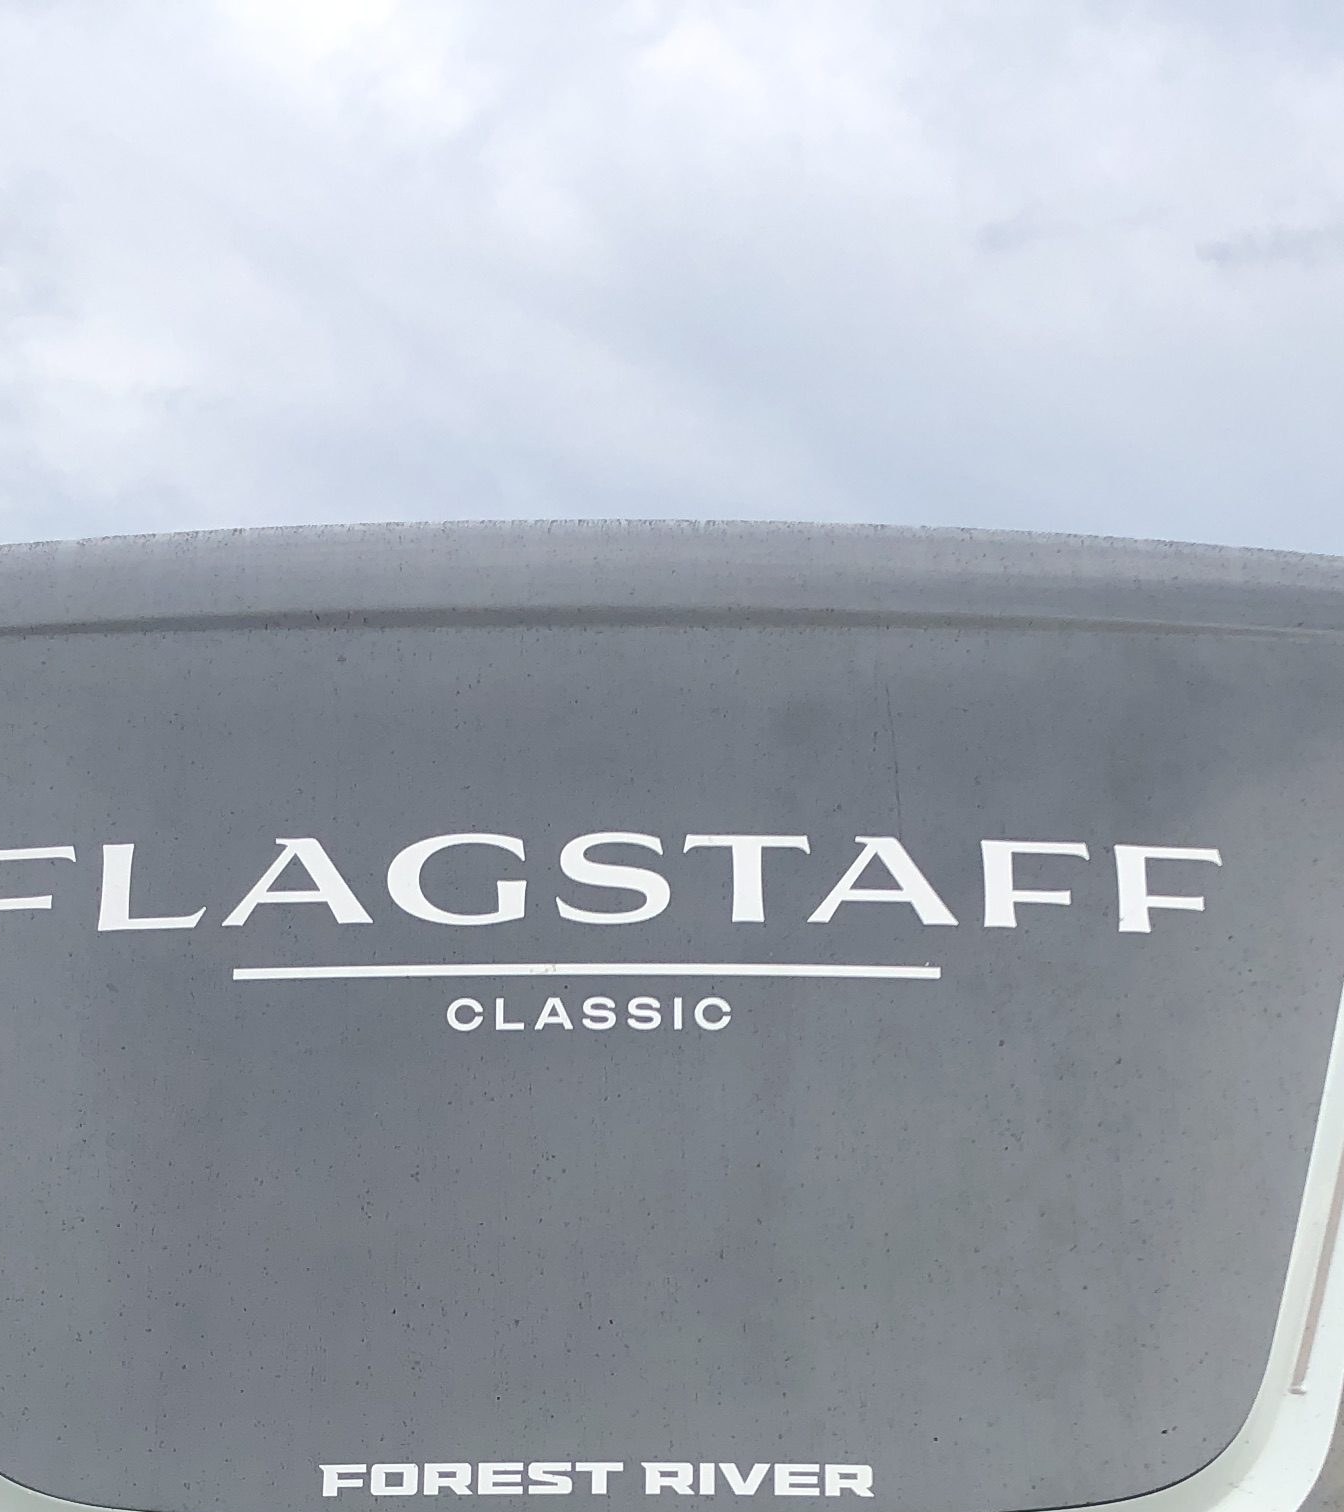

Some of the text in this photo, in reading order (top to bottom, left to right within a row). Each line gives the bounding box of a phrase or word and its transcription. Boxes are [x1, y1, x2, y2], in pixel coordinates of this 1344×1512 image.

[446, 996, 733, 1031] CLASSIC
[319, 1461, 875, 1498] FOREST RIVER
